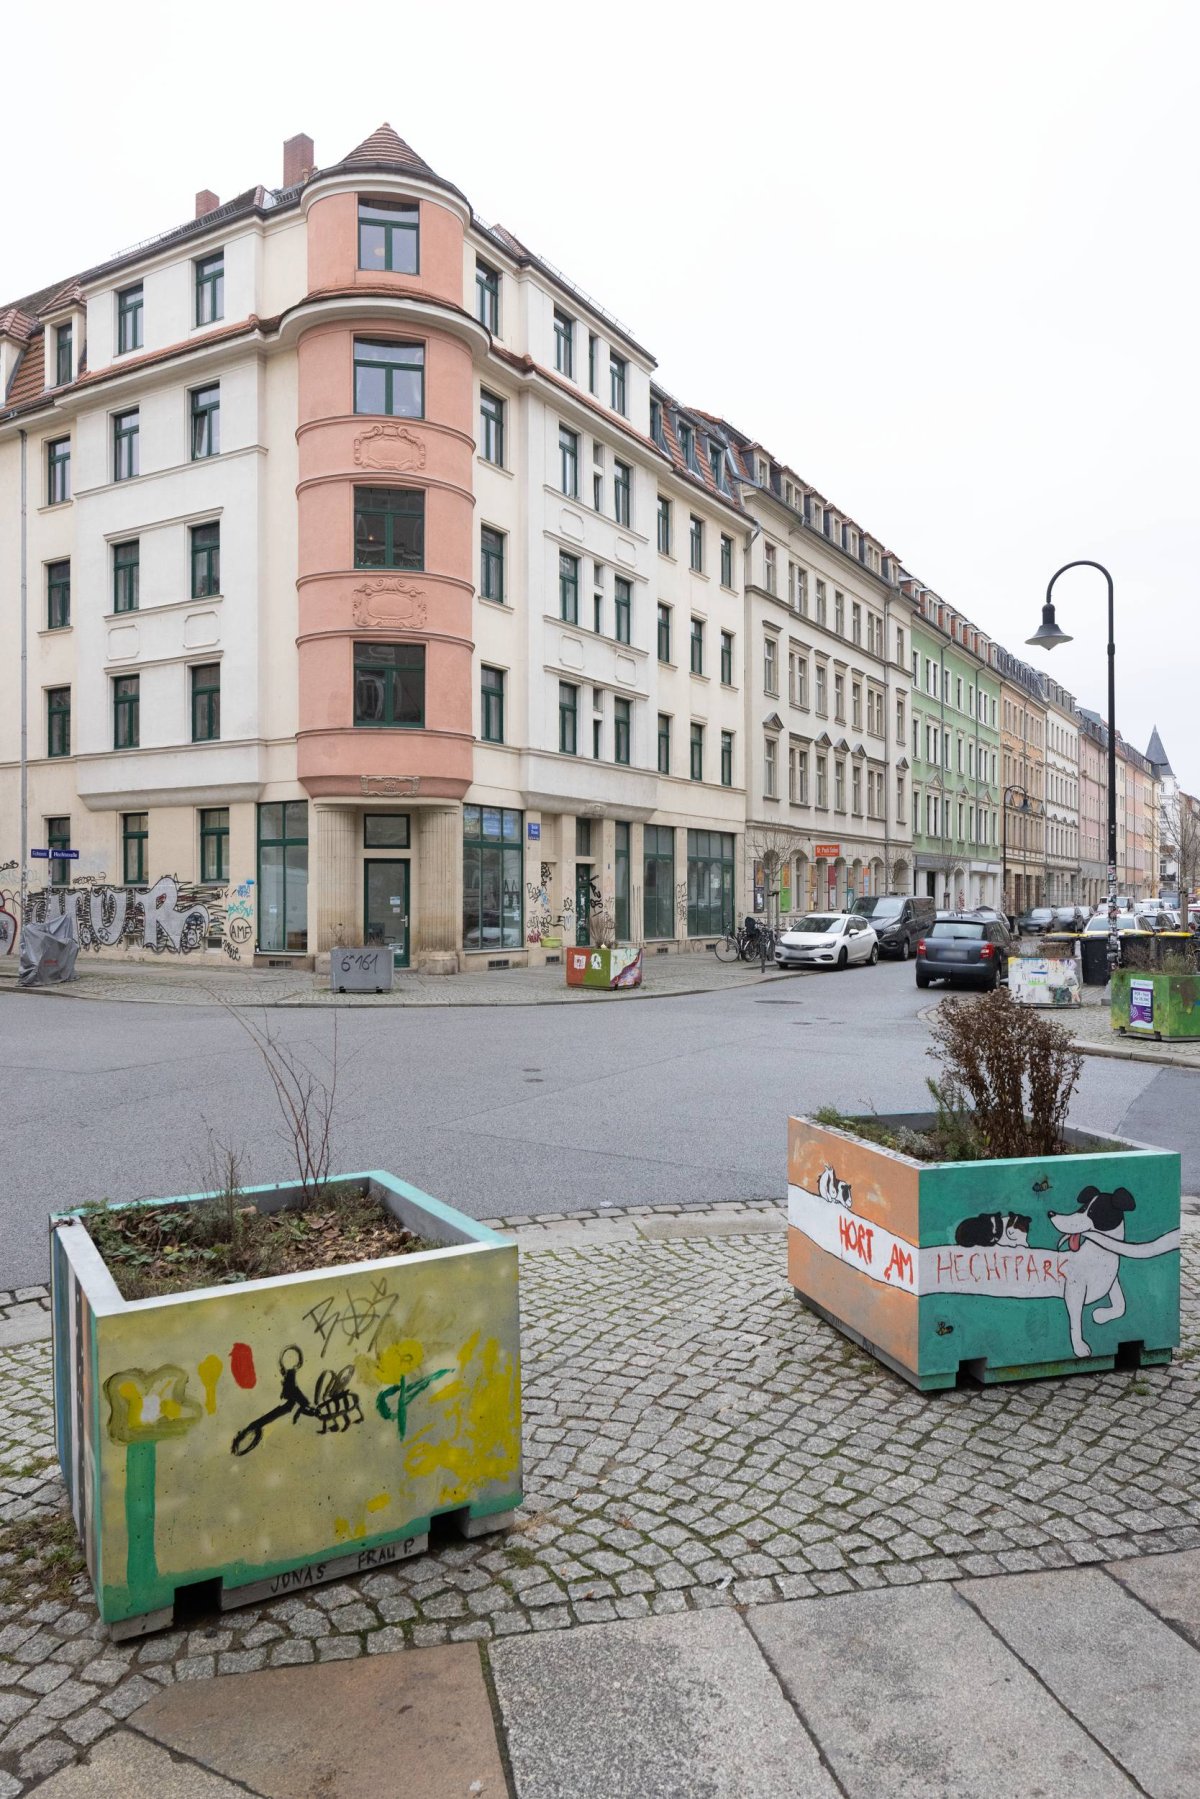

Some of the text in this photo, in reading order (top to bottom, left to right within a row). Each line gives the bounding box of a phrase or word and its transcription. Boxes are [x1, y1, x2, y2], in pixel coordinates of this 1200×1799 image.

[838, 1215, 914, 1285] HORT AM
[937, 1252, 1069, 1284] HECHTPARK
[270, 1564, 327, 1593] JONAS
[357, 1549, 396, 1569] FRAU
